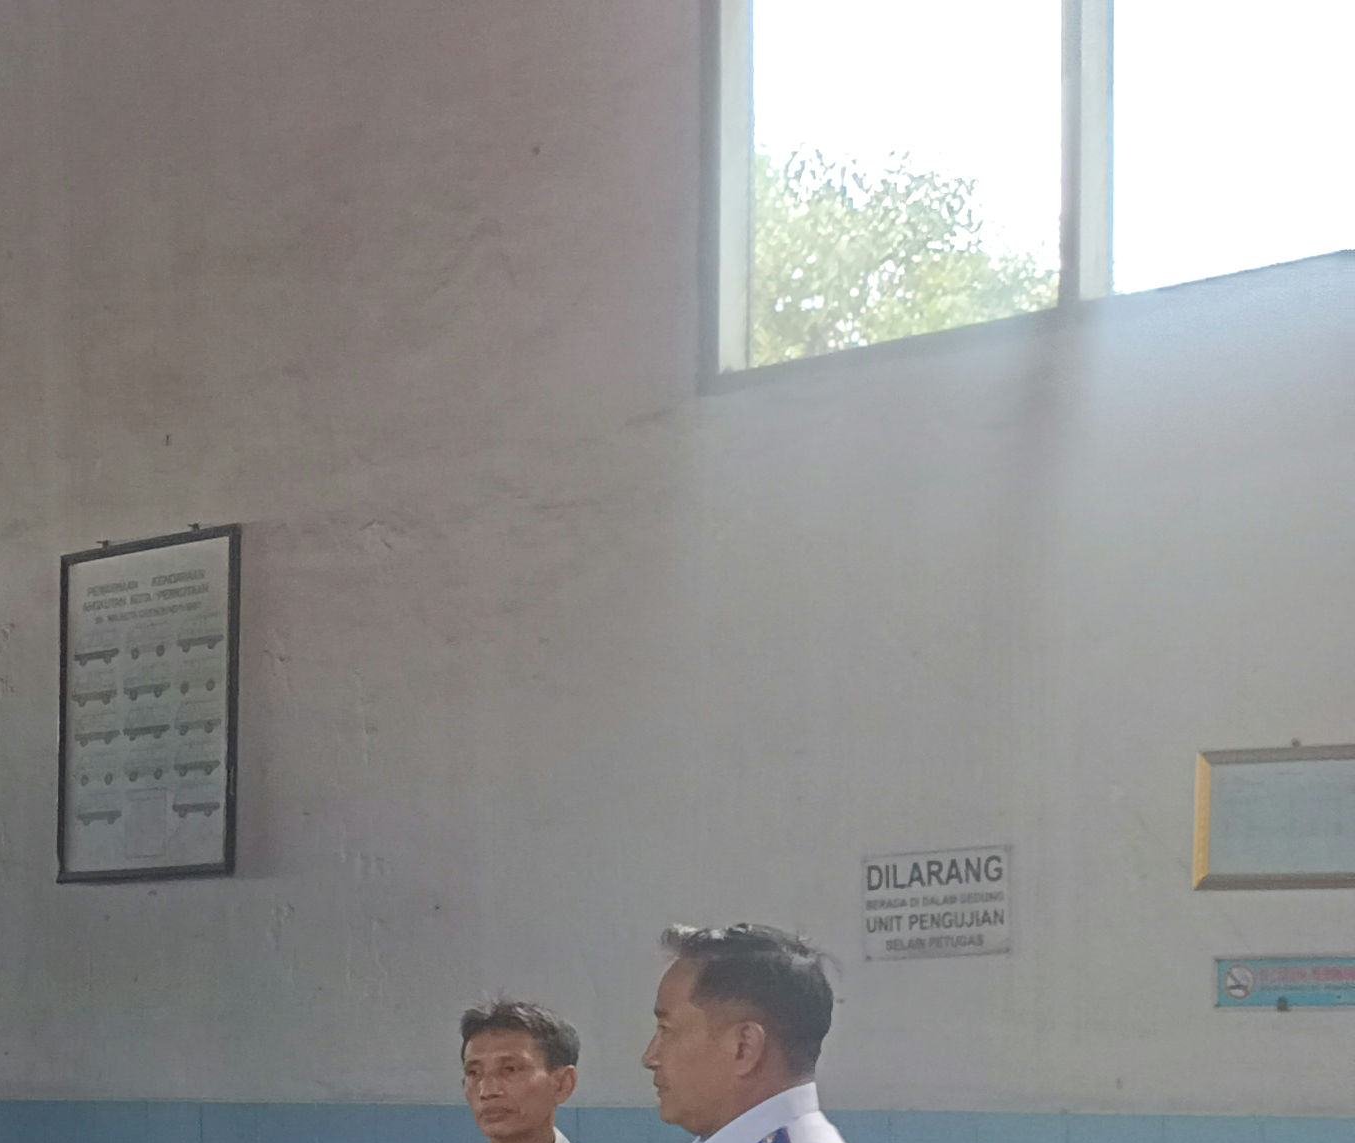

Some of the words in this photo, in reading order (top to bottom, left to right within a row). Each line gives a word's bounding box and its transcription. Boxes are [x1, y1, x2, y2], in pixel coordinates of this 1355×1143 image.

[866, 855, 1003, 891] DILARANG
[866, 915, 903, 933] UNIT
[908, 909, 1005, 931] PENGUJIAN
